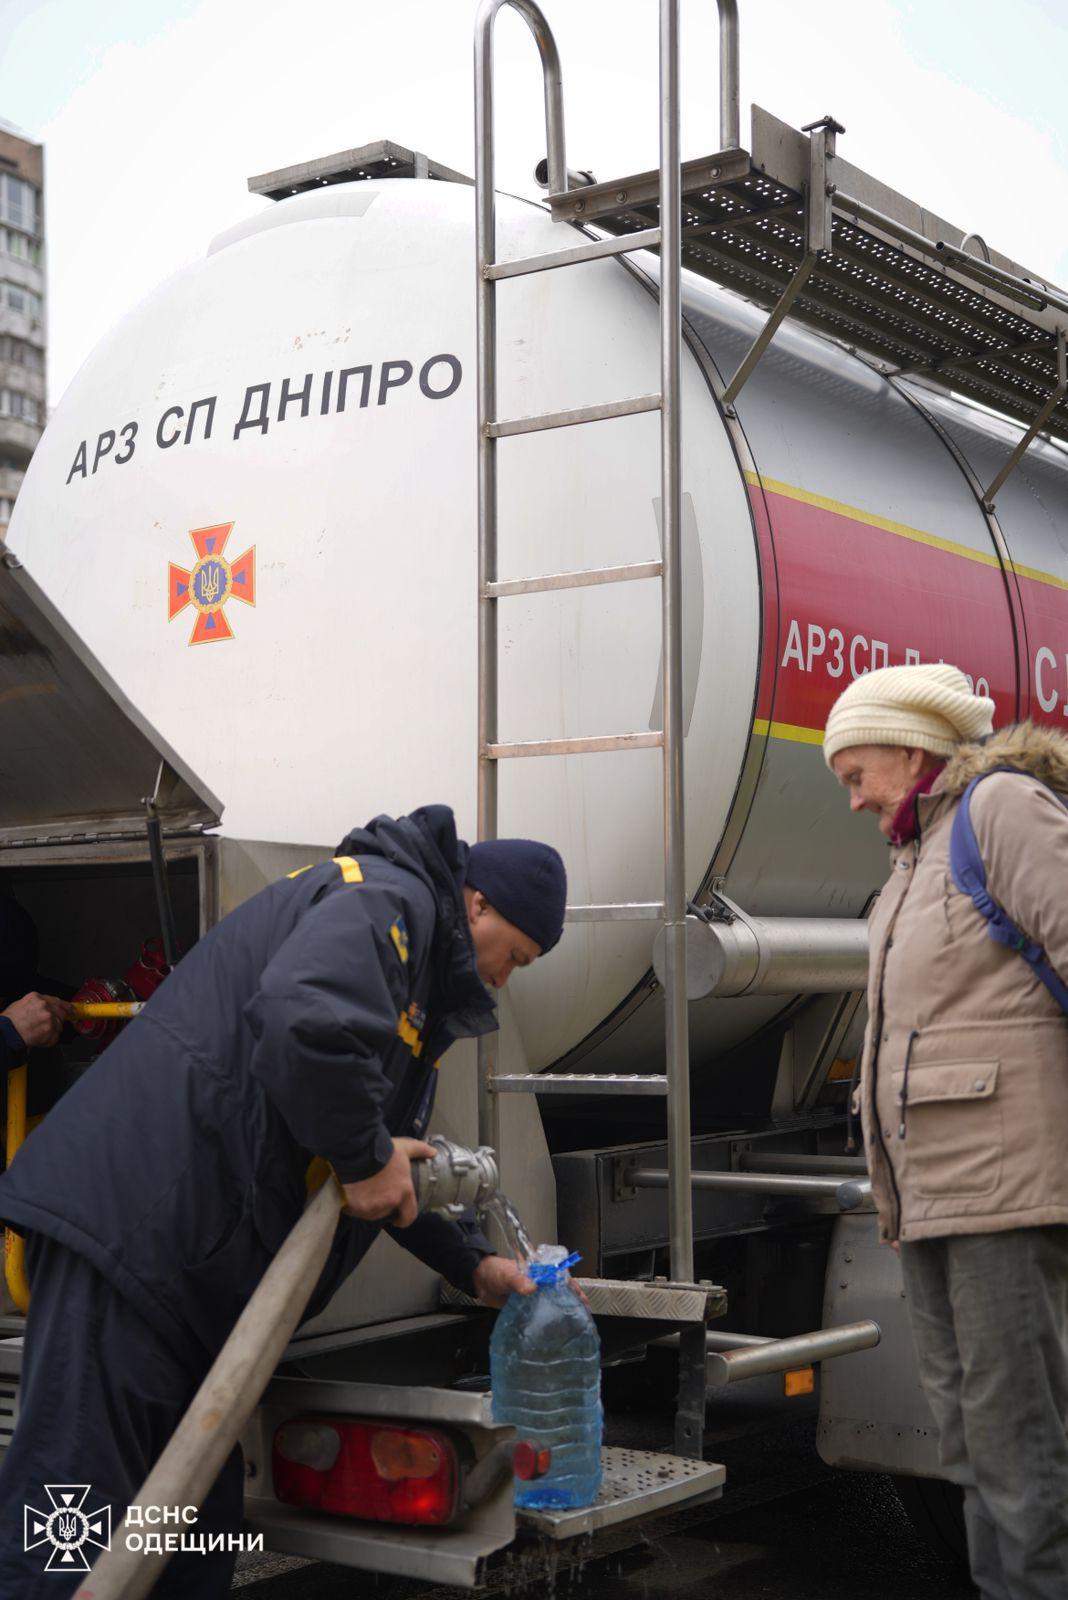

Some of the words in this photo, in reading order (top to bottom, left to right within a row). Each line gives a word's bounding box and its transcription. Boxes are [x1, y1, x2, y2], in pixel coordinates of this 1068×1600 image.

[66, 422, 138, 484] АРЗ
[156, 396, 217, 449] СП
[233, 353, 463, 440] ДНІПРО
